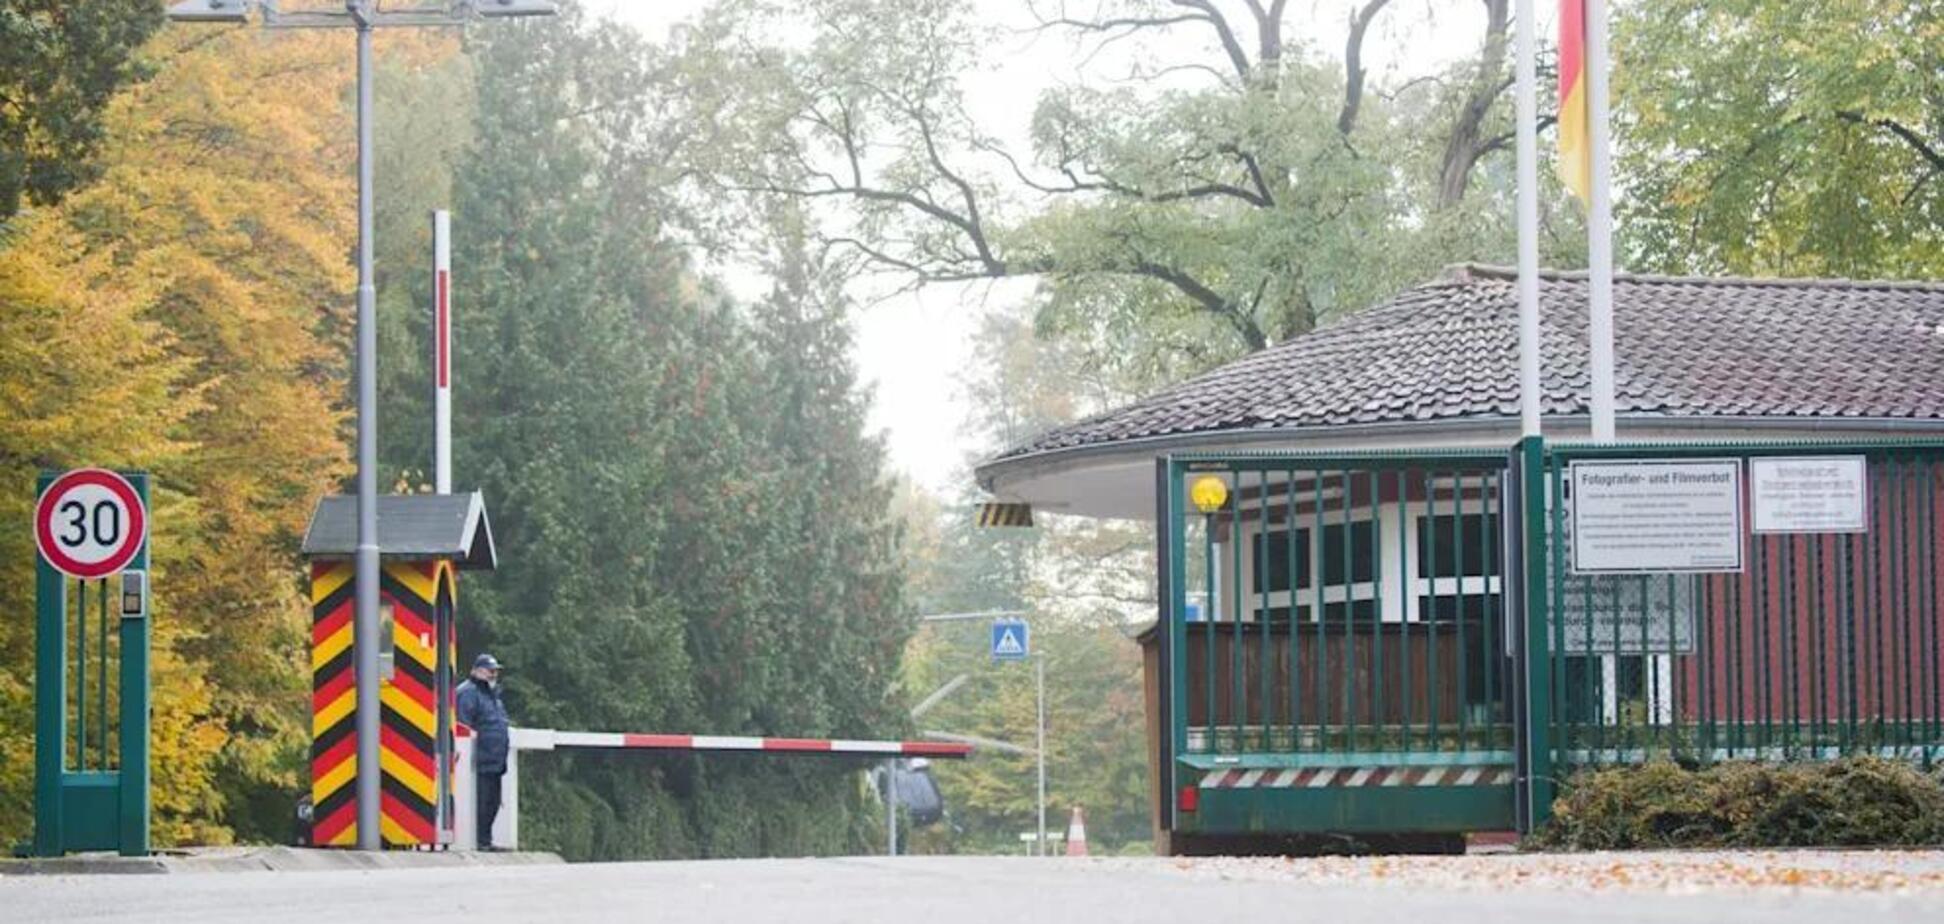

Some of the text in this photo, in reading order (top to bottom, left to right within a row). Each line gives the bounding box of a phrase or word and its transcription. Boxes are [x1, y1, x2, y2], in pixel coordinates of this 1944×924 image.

[1582, 472, 1730, 486] Fotografier- und Filmverbot
[60, 500, 119, 547] 30
